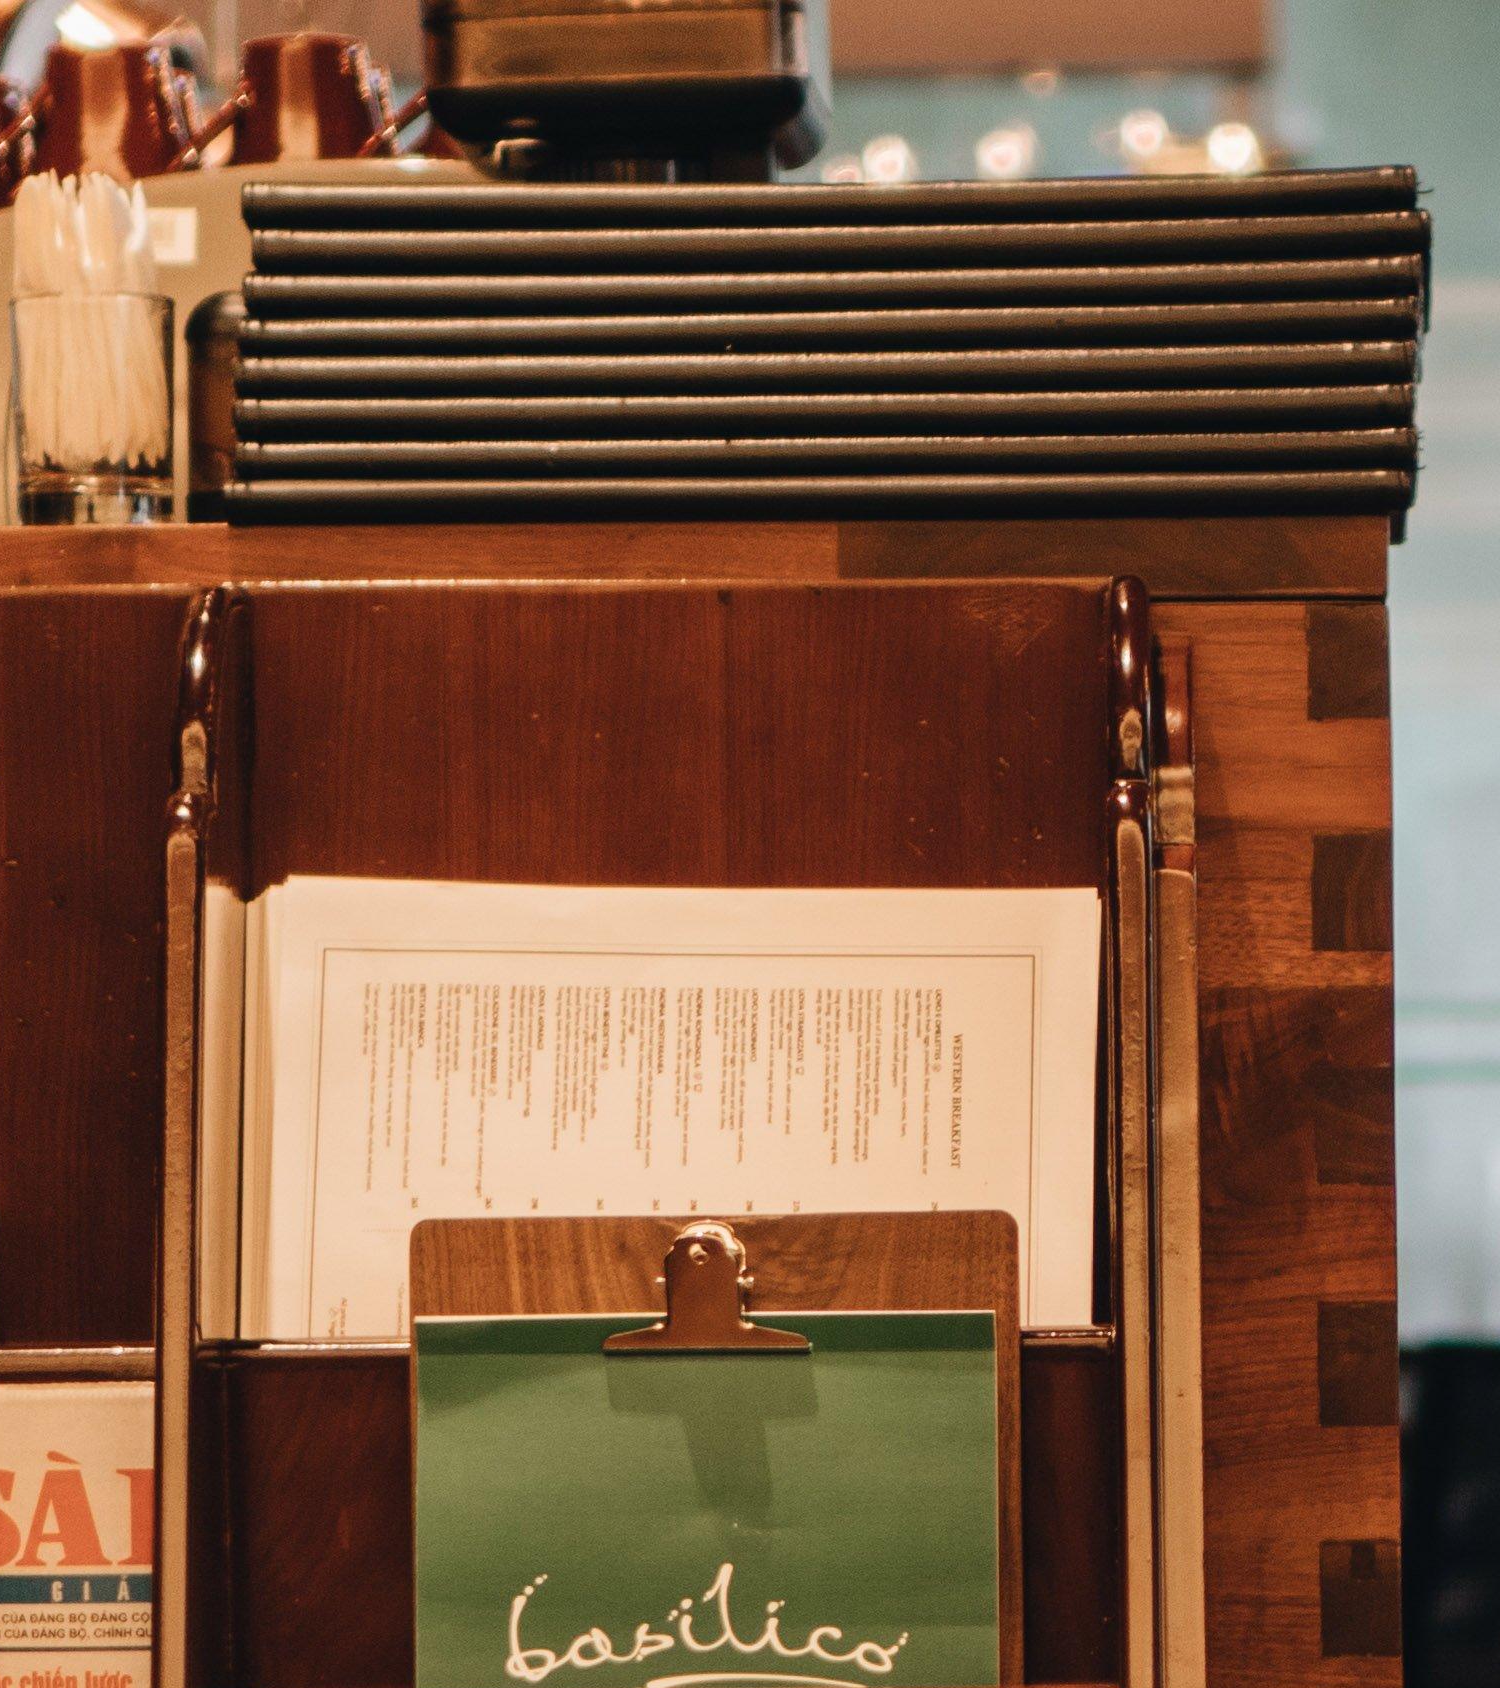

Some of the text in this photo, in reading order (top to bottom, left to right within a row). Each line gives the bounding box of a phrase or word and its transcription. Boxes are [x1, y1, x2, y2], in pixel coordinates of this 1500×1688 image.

[951, 1034, 963, 1169] WESTERN BREAKFAST
[507, 1563, 908, 1682] basilico
